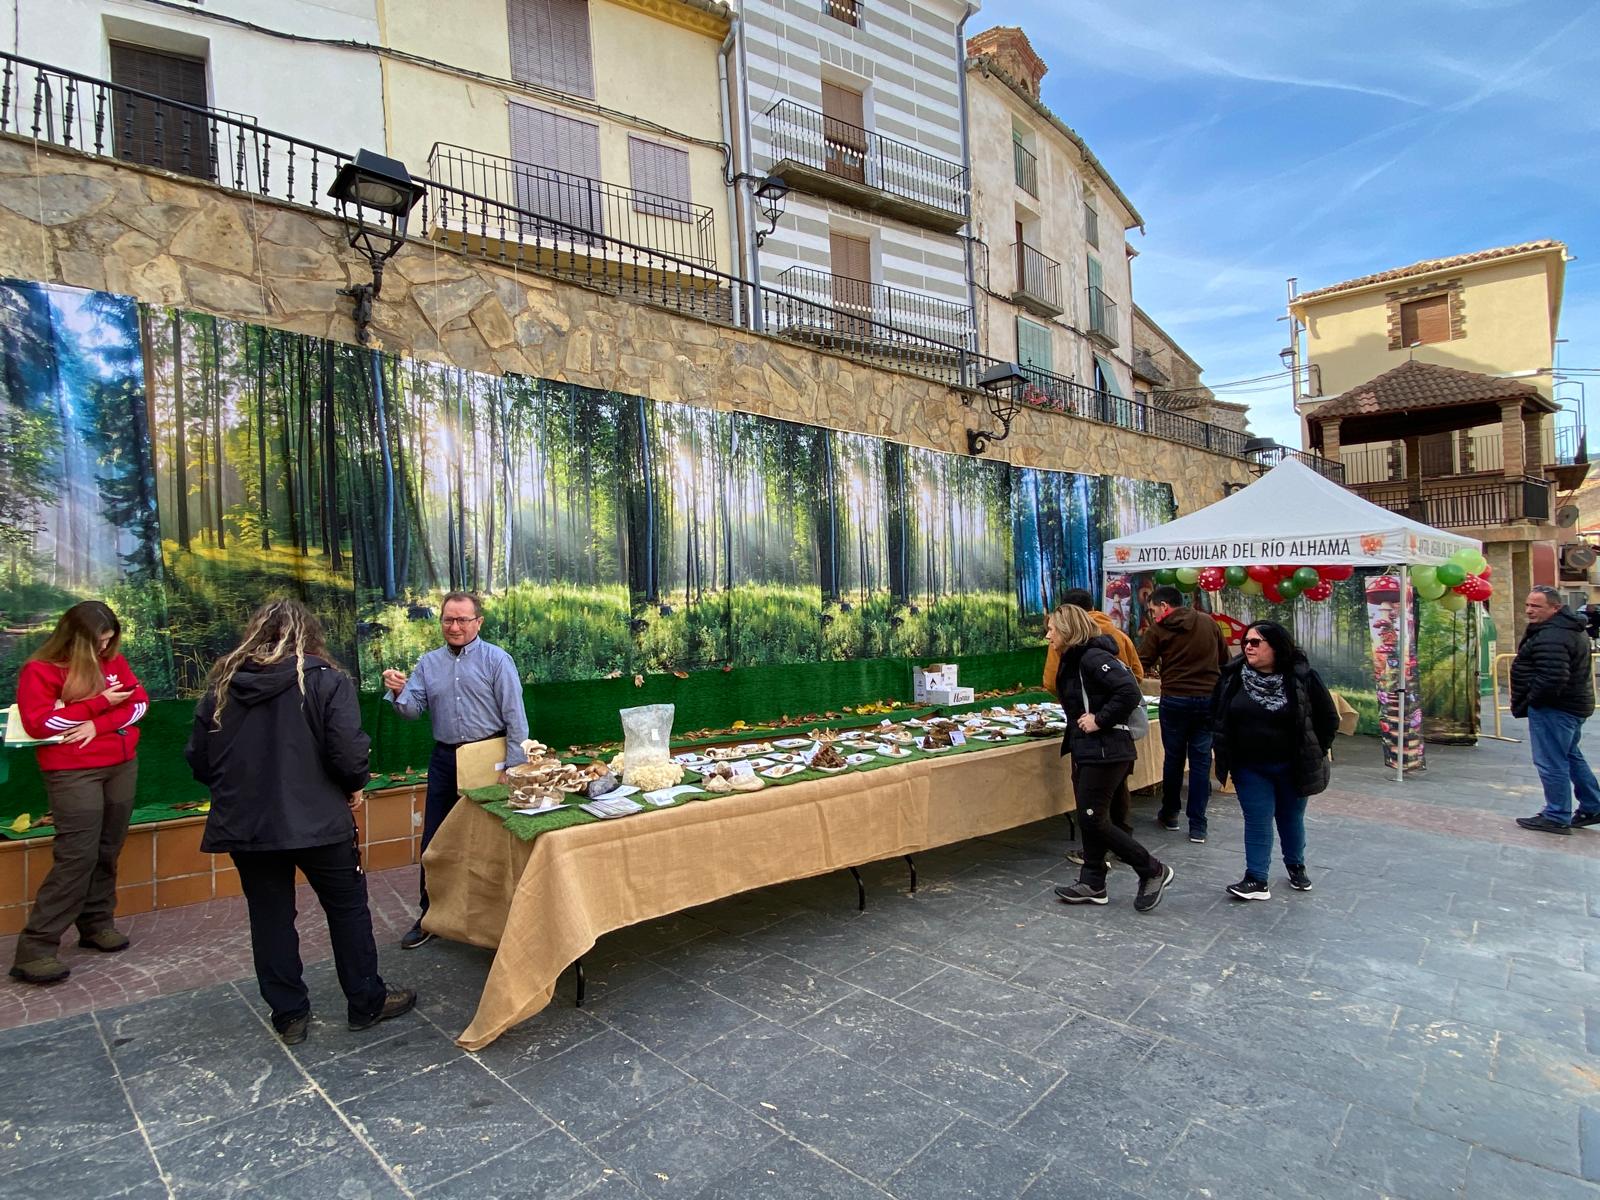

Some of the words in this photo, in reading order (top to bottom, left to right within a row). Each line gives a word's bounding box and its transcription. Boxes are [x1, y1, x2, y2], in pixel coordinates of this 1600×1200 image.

[1138, 546, 1170, 562] AYTO.
[1174, 544, 1227, 561] AGUILAR
[1232, 543, 1256, 559] DEL
[1261, 538, 1285, 558] RÍO
[1289, 538, 1351, 557] ALHAMA
